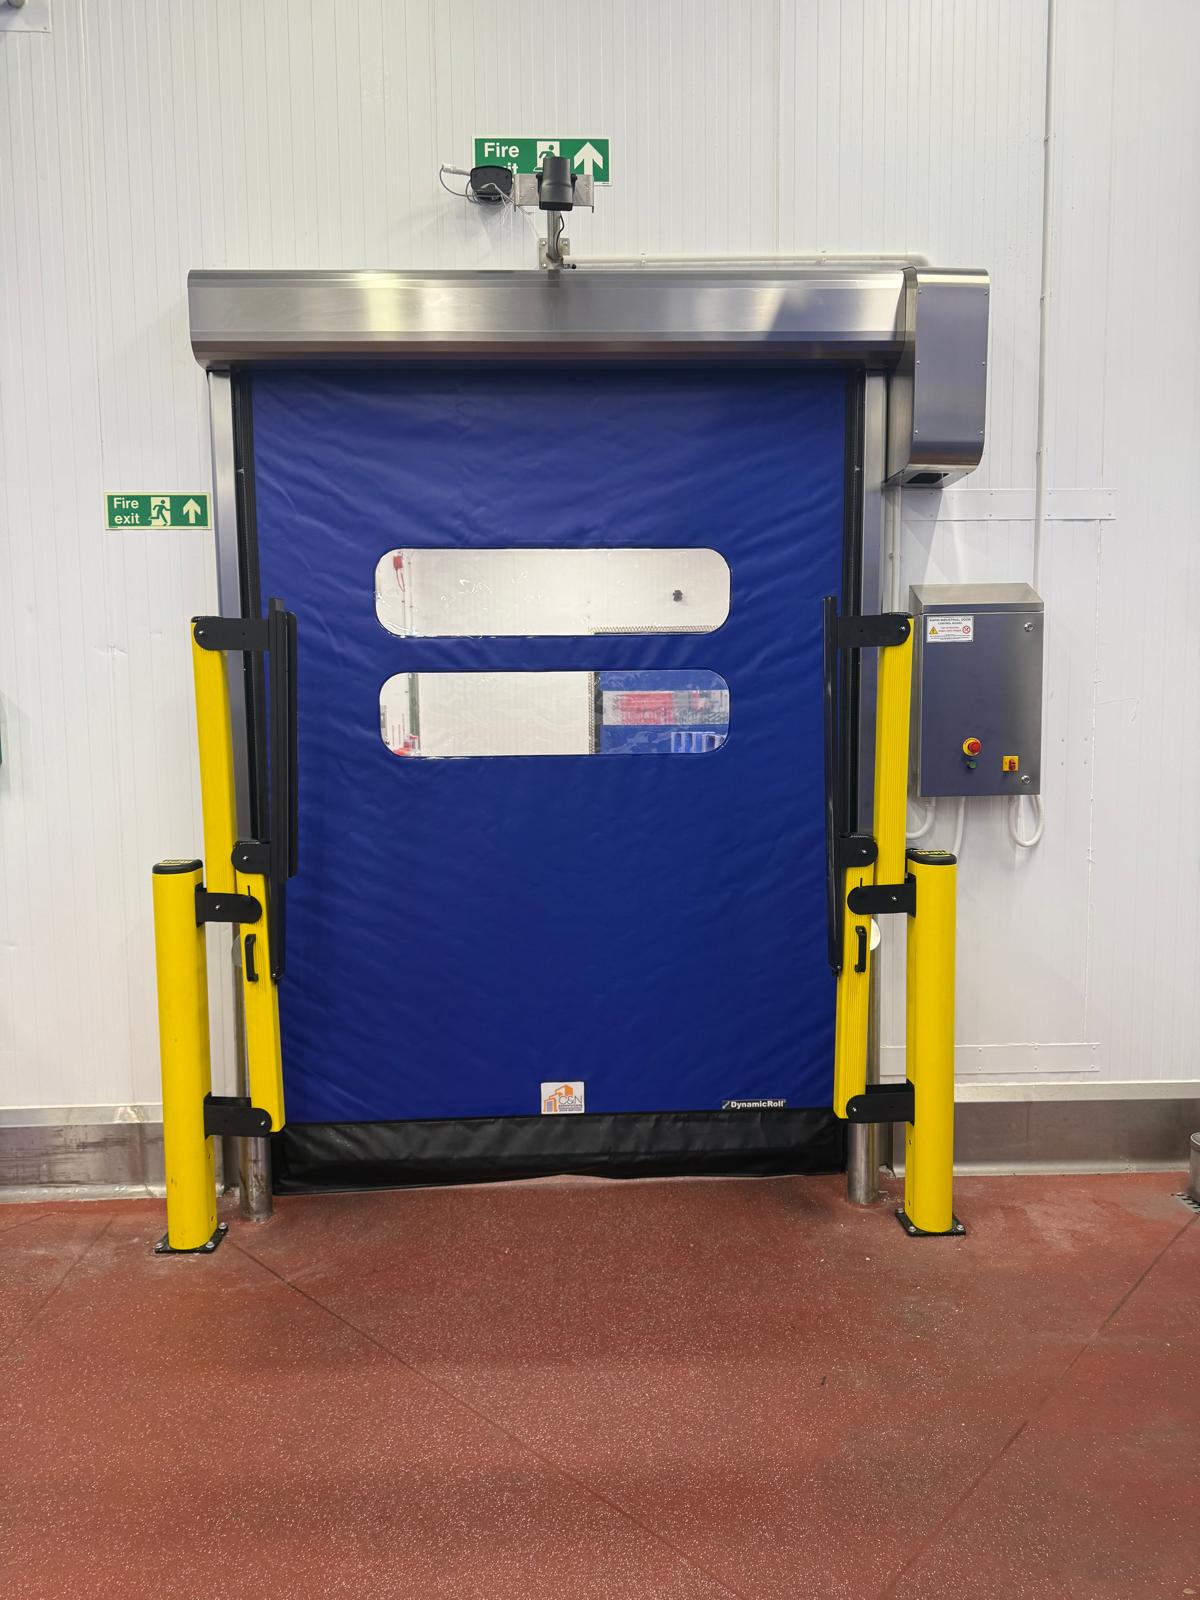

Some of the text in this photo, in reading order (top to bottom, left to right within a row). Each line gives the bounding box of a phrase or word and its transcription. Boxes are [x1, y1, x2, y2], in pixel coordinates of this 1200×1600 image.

[484, 142, 520, 158] Fire
[114, 497, 139, 509] Fire
[114, 513, 140, 524] exit
[730, 1100, 784, 1109] DynamicRoll
